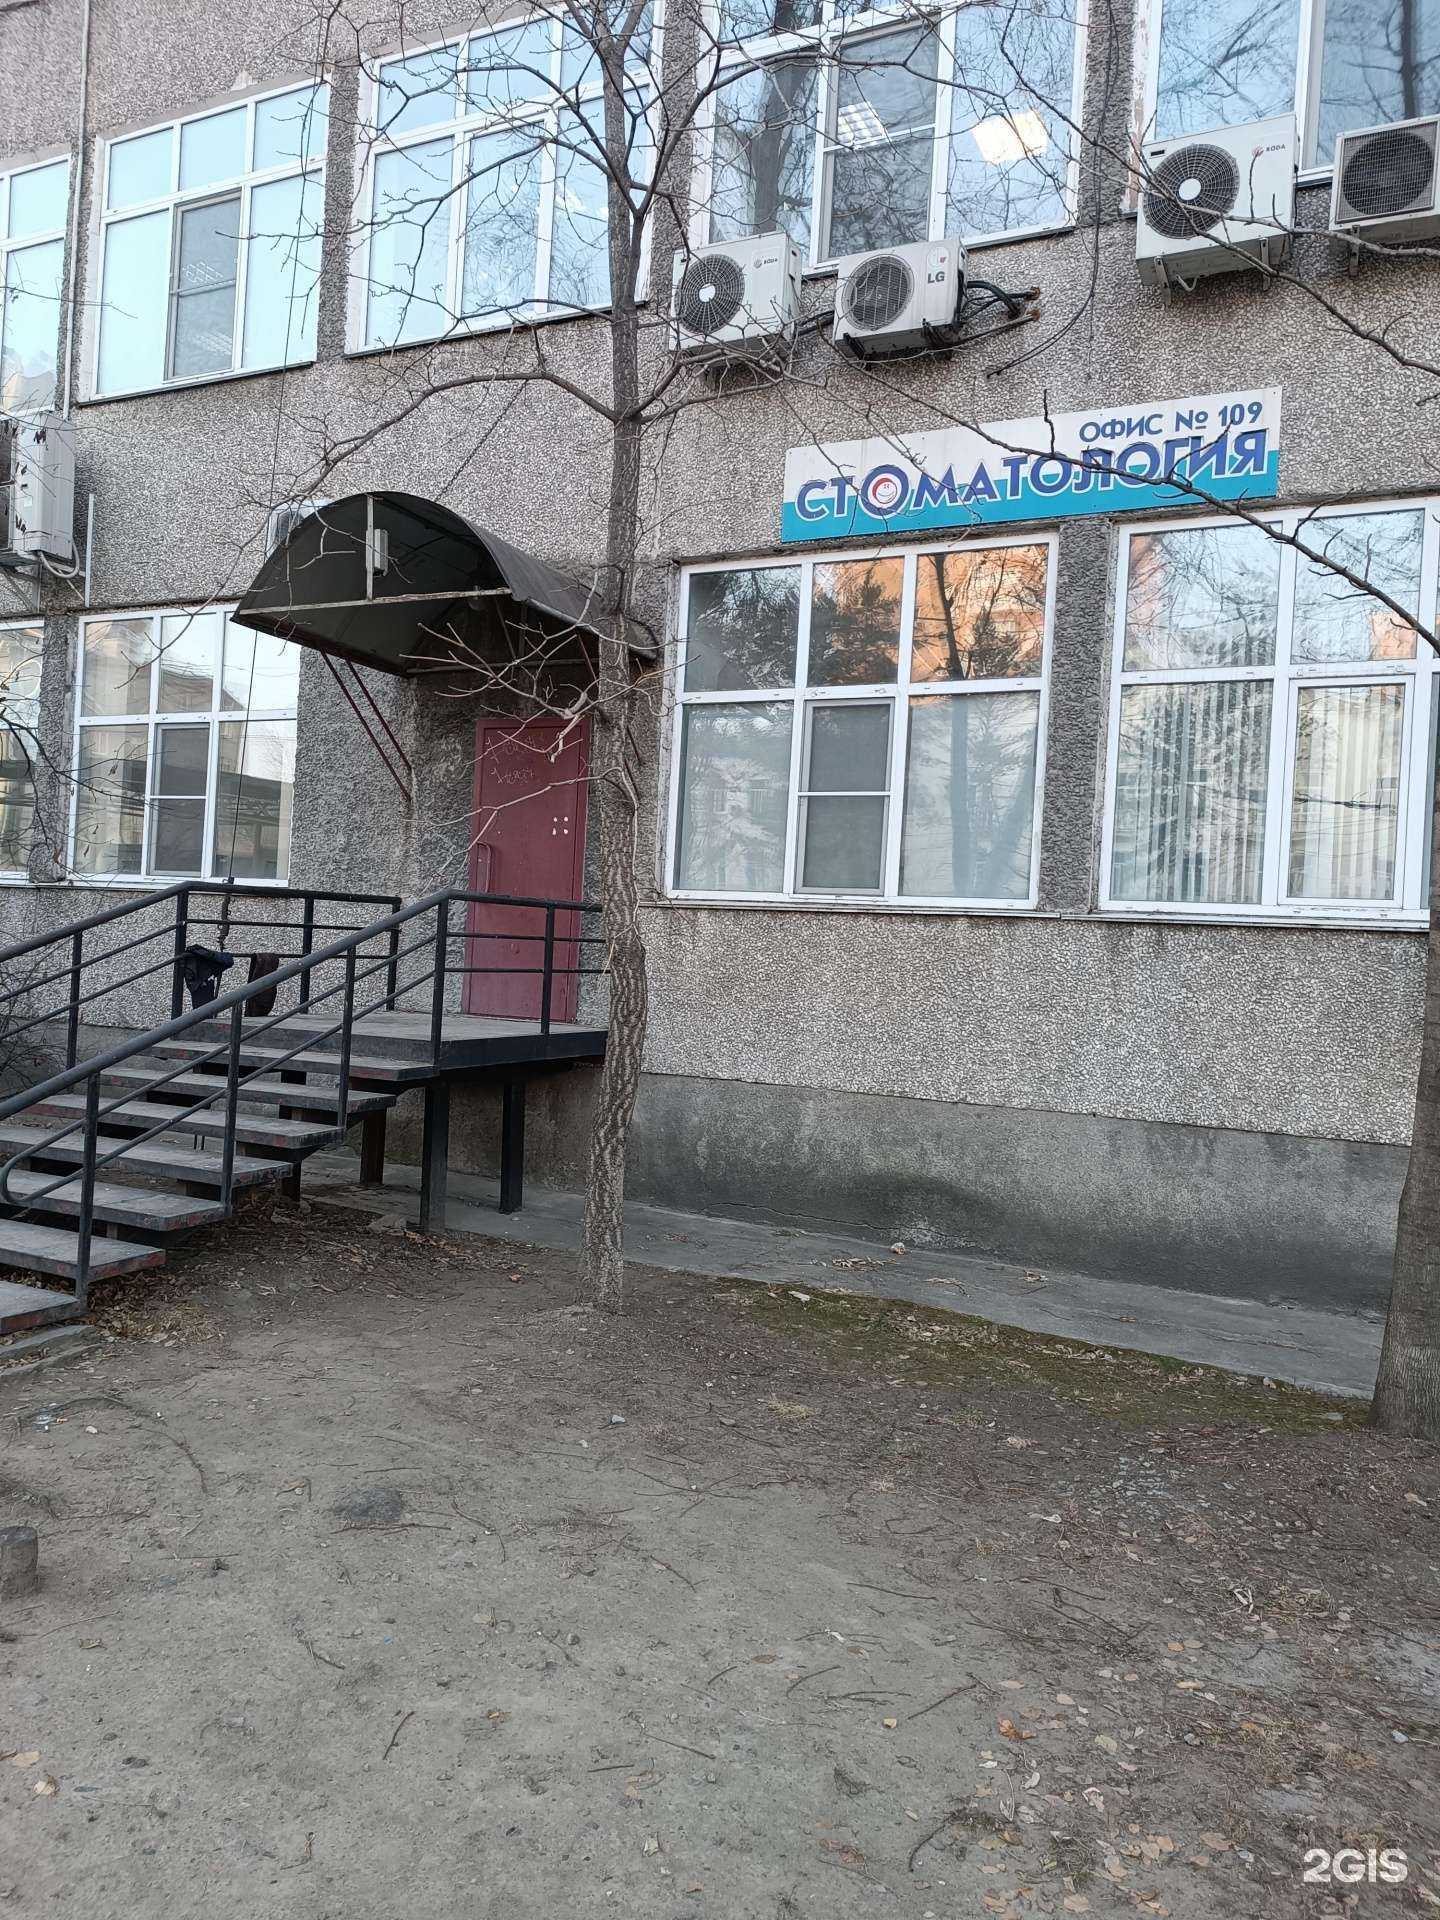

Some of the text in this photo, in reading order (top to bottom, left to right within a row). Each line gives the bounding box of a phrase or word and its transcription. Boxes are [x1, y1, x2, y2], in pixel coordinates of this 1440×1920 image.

[927, 271, 946, 284] LG
[1078, 401, 1263, 443] ОФИС № 109
[797, 428, 1268, 521] СТОМАТОЛОГИЯ
